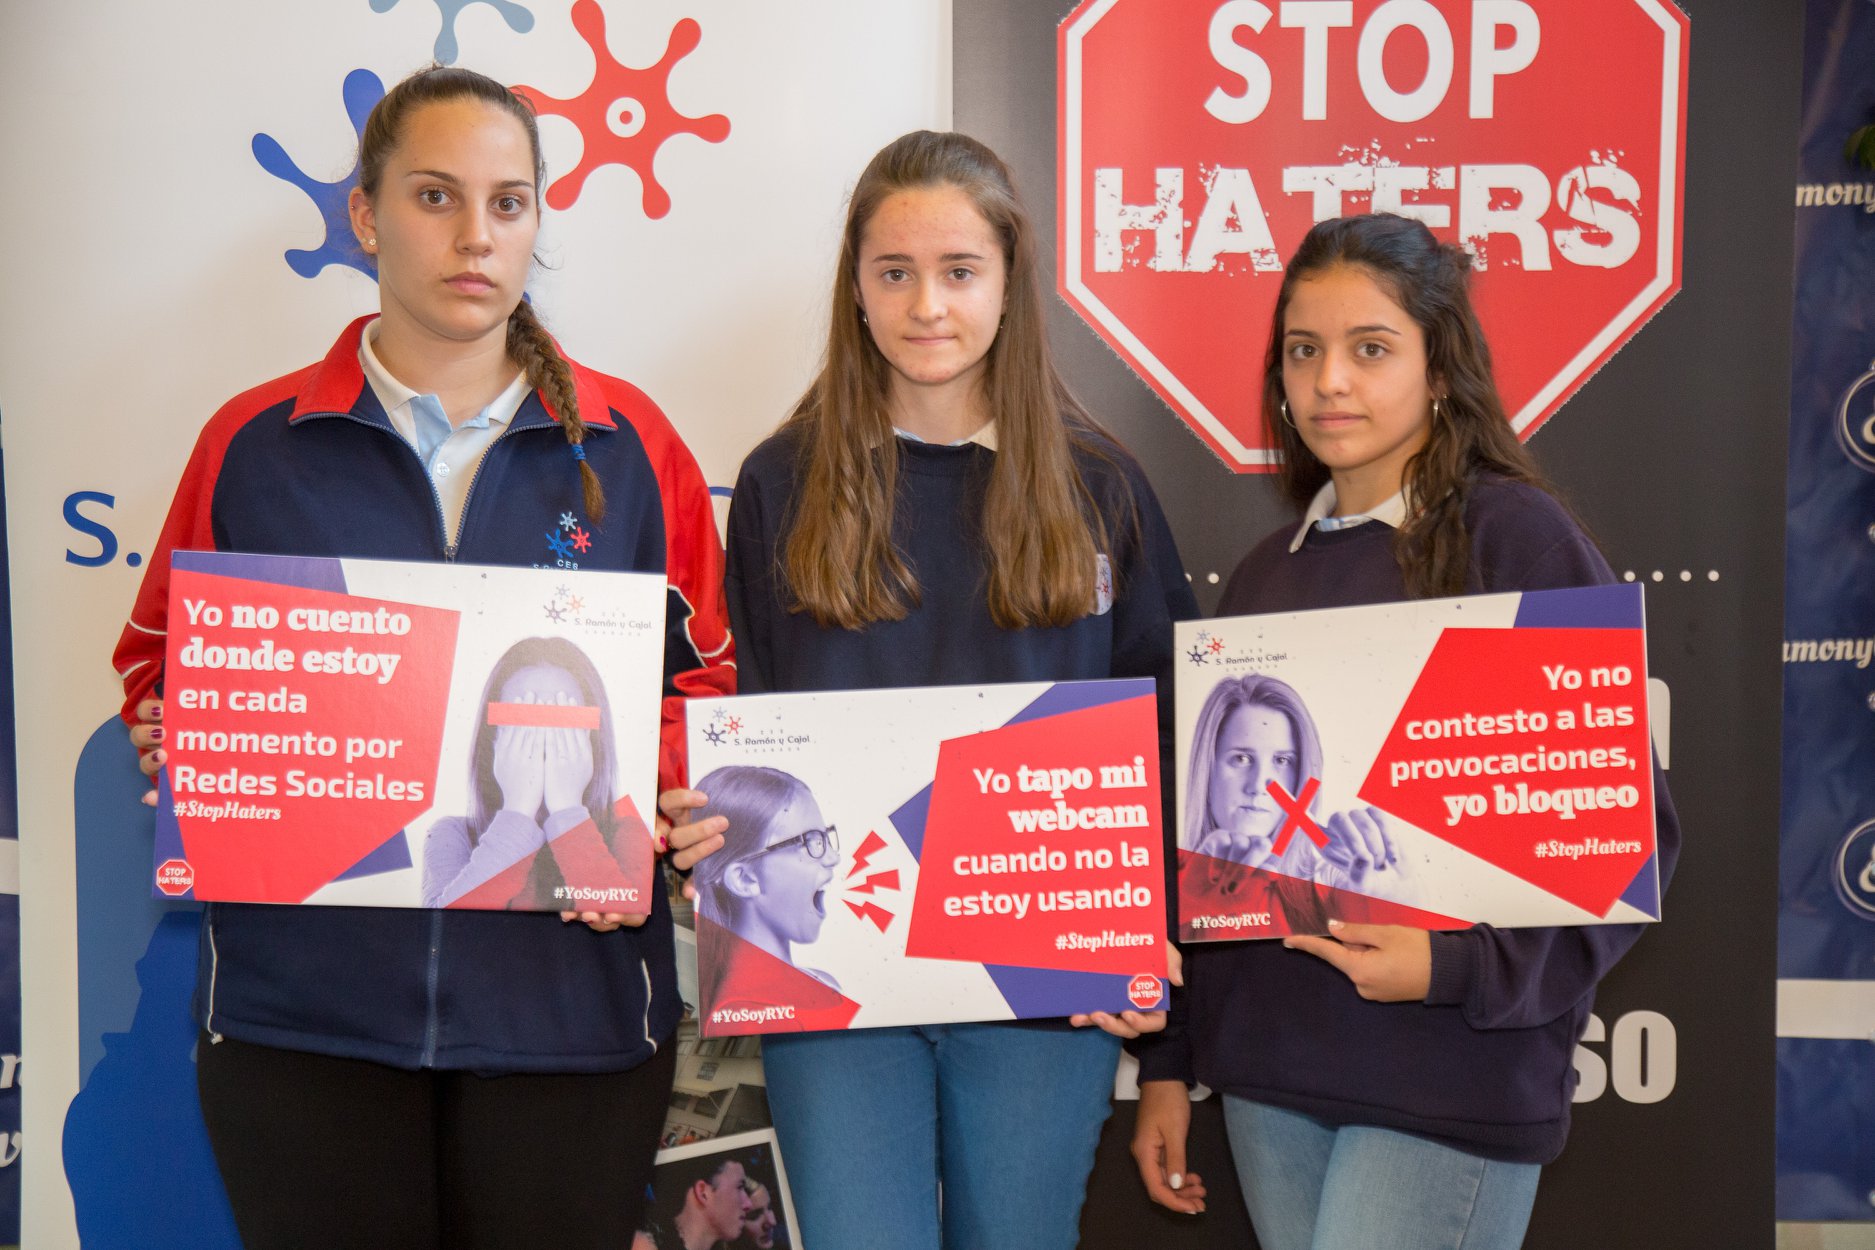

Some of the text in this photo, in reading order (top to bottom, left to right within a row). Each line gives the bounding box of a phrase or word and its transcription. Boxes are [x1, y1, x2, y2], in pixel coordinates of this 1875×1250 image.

[1204, 0, 1540, 124] STOP
[1094, 152, 1642, 273] HATERS
[63, 491, 142, 567] S.
[184, 599, 411, 635] Yo no cuento
[180, 637, 401, 684] donde estoy
[1543, 665, 1631, 690] Yo no
[179, 687, 307, 713] en cada
[1407, 703, 1633, 740] contesto a las
[177, 731, 402, 763] momento por
[973, 756, 1147, 799] Yo tapo mi
[1391, 746, 1635, 787] provocaciones,
[175, 766, 424, 801] Redes Sociales
[173, 800, 280, 822] #StopHaters
[1008, 801, 1149, 832] webcam
[1444, 783, 1638, 826] yo bloqueo
[954, 842, 1149, 875] cuando no la
[1535, 838, 1641, 860] #StopHaters
[165, 867, 187, 877] STOP
[554, 886, 638, 903] #YoSoyRYC
[944, 882, 1151, 919] estoy usando
[1192, 913, 1270, 929] #YoSoyRYC
[1056, 931, 1154, 952] #StopHaters
[1135, 981, 1155, 990] STOP
[713, 1006, 794, 1024] #YoSoyRYC
